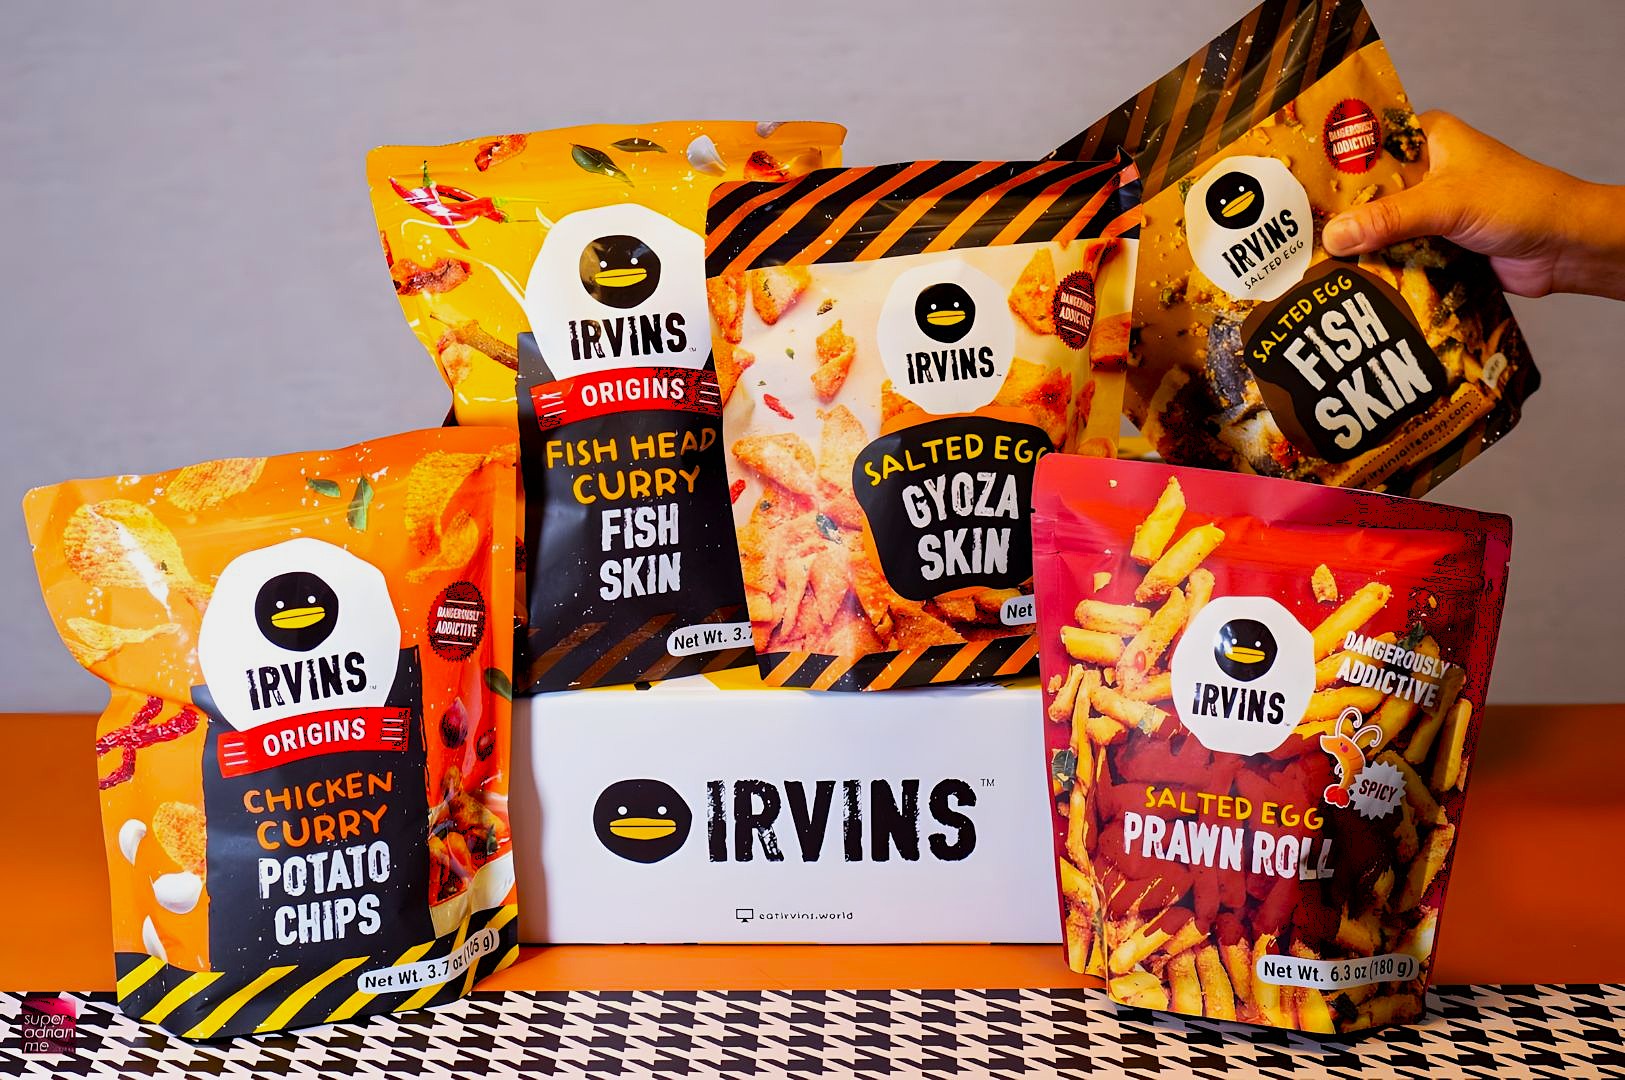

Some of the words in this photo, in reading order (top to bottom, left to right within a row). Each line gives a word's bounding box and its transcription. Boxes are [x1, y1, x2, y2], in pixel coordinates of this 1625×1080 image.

[1333, 132, 1375, 156] ADDICTIVE
[1222, 209, 1299, 279] IRVINS
[1244, 256, 1282, 290] SALTED
[1284, 240, 1304, 260] EGG
[568, 312, 688, 360] IRVINS
[1253, 298, 1313, 363] SALTED
[1313, 275, 1352, 305] EGG
[1283, 291, 1391, 391] FISH
[906, 346, 995, 385] IRVINS
[581, 378, 685, 407] ORIGINS
[1315, 339, 1433, 450] SKIN
[546, 437, 618, 469] FISH
[631, 428, 717, 461] HEAD
[864, 433, 984, 487] SALTED
[573, 464, 700, 505] CURRY
[902, 471, 1019, 529] GYOZA
[601, 502, 679, 552] FISH
[599, 551, 682, 601] SKIN
[917, 527, 1012, 581] SKIN
[435, 620, 478, 637] ADDICTIVE
[1006, 603, 1033, 619] Net
[674, 633, 699, 650] Net
[703, 629, 728, 645] Wt.
[1343, 630, 1451, 680] DANGEROUSLY
[246, 651, 367, 711] IRVINS
[1192, 682, 1286, 725] IRVINS
[1336, 657, 1441, 708] ADDICTIVE
[262, 718, 366, 757] ORIGINS
[243, 771, 393, 814] CHICKEN
[1145, 785, 1253, 821] SALTED
[1261, 801, 1325, 831] EGG
[1359, 778, 1398, 802] SPICY
[256, 804, 388, 851] CURRY
[706, 778, 978, 863] IRVINS
[258, 840, 391, 900] POTATO
[1123, 811, 1245, 872] PRAWN
[1252, 830, 1335, 881] ROLL
[273, 898, 382, 947] CHIPS
[365, 975, 393, 988] Net
[398, 970, 423, 985] Wt.
[427, 960, 450, 979] 3.7
[453, 958, 463, 970] oz
[483, 930, 495, 951] g)
[1264, 961, 1292, 979] Net
[1297, 965, 1324, 983] Wt.
[1330, 964, 1351, 982] 6.3
[1354, 967, 1367, 979] oz
[1369, 958, 1394, 981] (180
[1397, 957, 1415, 978] g)
